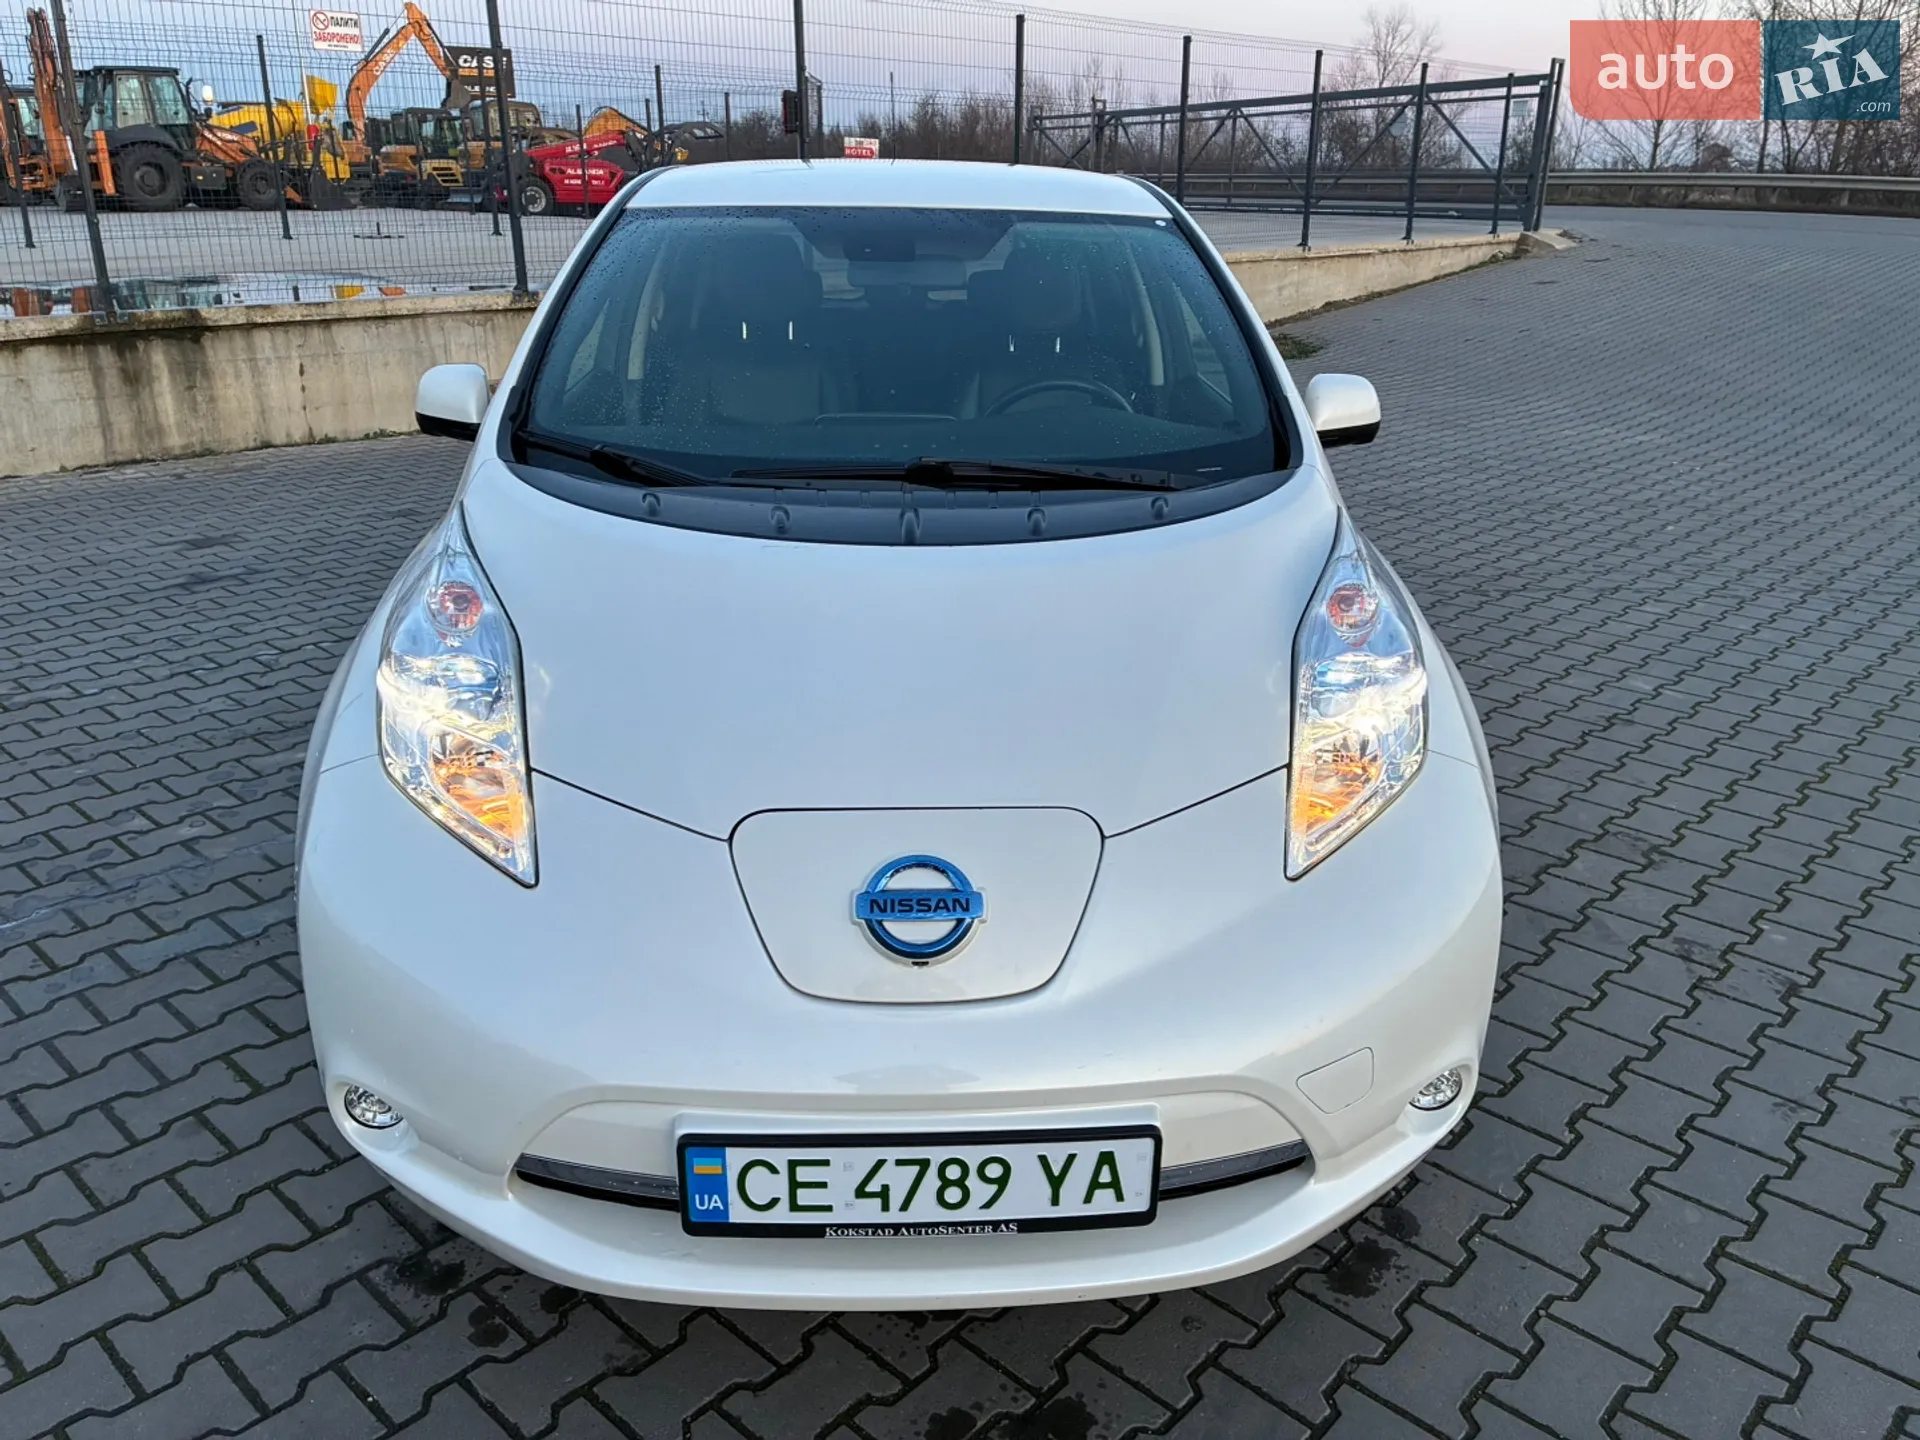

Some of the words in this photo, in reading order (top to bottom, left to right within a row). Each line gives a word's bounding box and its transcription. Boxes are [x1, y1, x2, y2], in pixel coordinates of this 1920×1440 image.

[330, 16, 359, 28] ПАЛИТИ
[313, 31, 361, 45] ЗАБОРОНЕНО!
[373, 48, 396, 76] CASE
[845, 147, 873, 156] HOTEL
[869, 897, 970, 914] NISSAN
[737, 1158, 833, 1212] CE
[854, 1155, 1012, 1212] 4789
[1036, 1150, 1125, 1207] YA
[695, 1194, 724, 1210] UA
[997, 1222, 1018, 1233] AS
